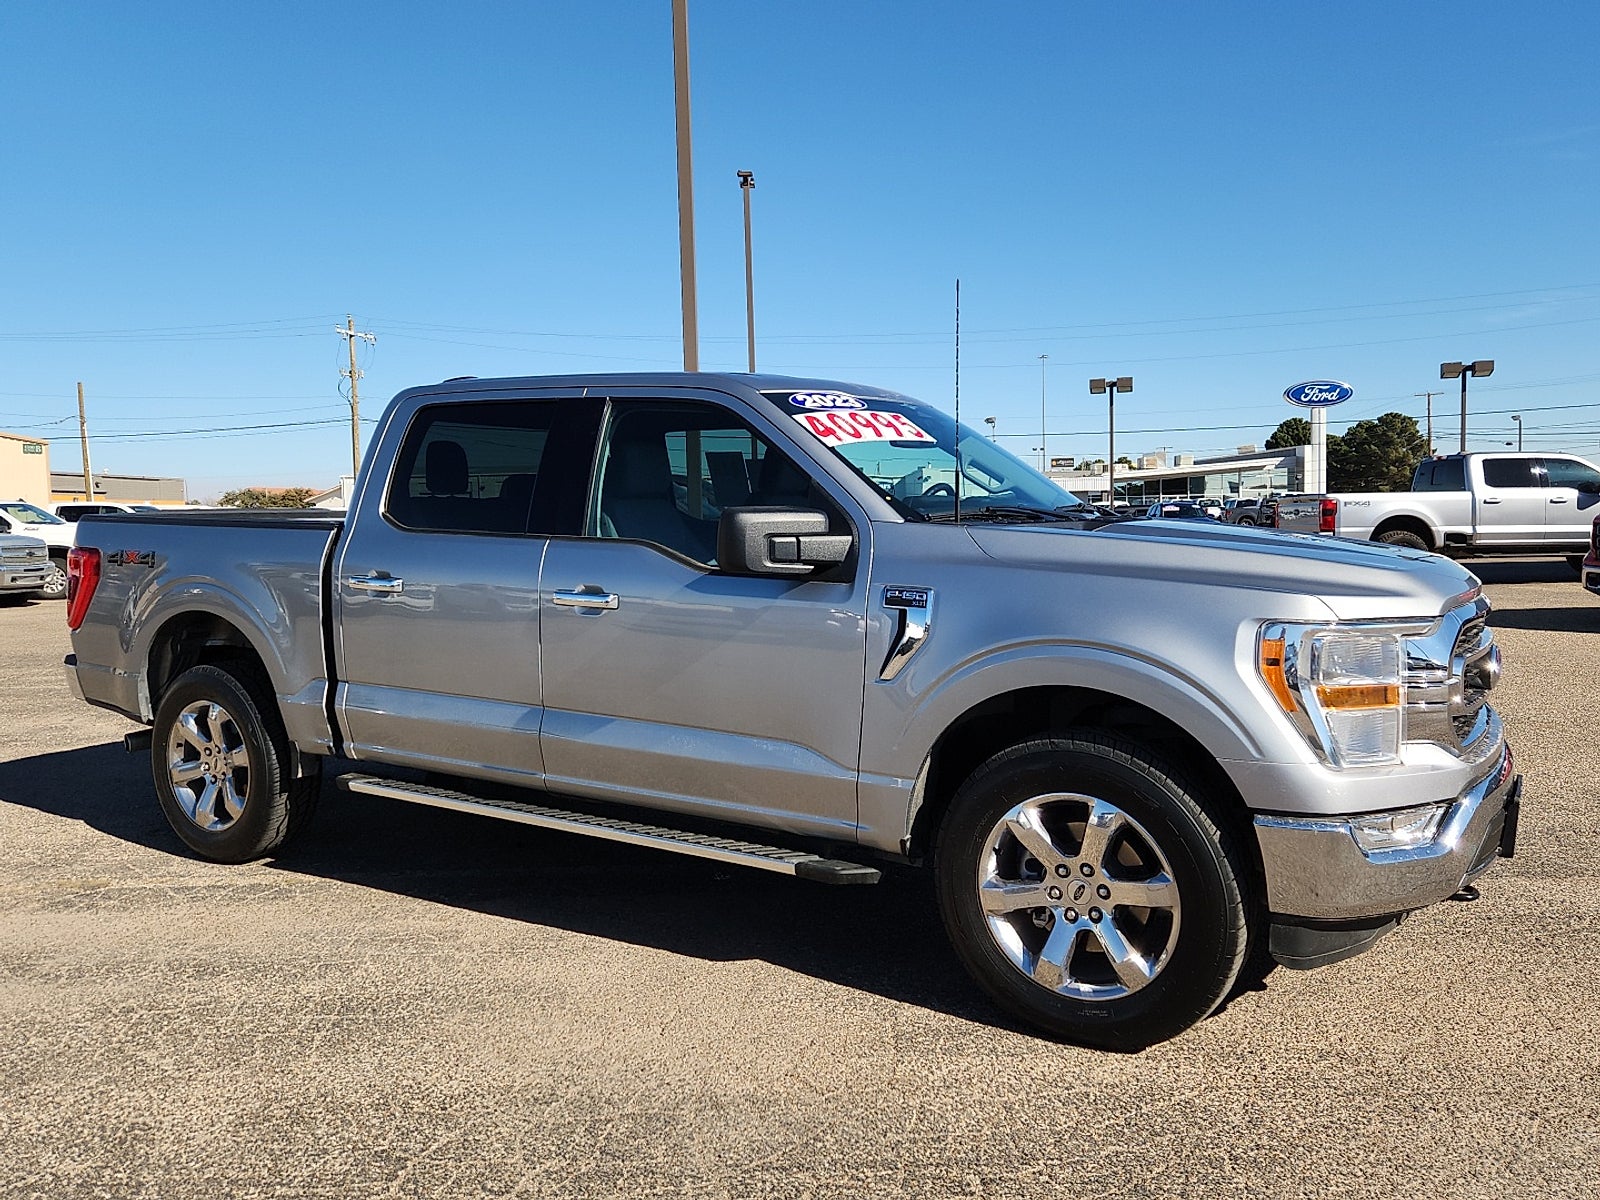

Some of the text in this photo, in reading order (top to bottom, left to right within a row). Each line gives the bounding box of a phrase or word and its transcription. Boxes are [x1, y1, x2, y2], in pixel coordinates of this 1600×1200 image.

[1300, 385, 1340, 402] Ford
[804, 412, 925, 442] 40995
[1343, 500, 1371, 508] FX4
[886, 590, 927, 600] F-150
